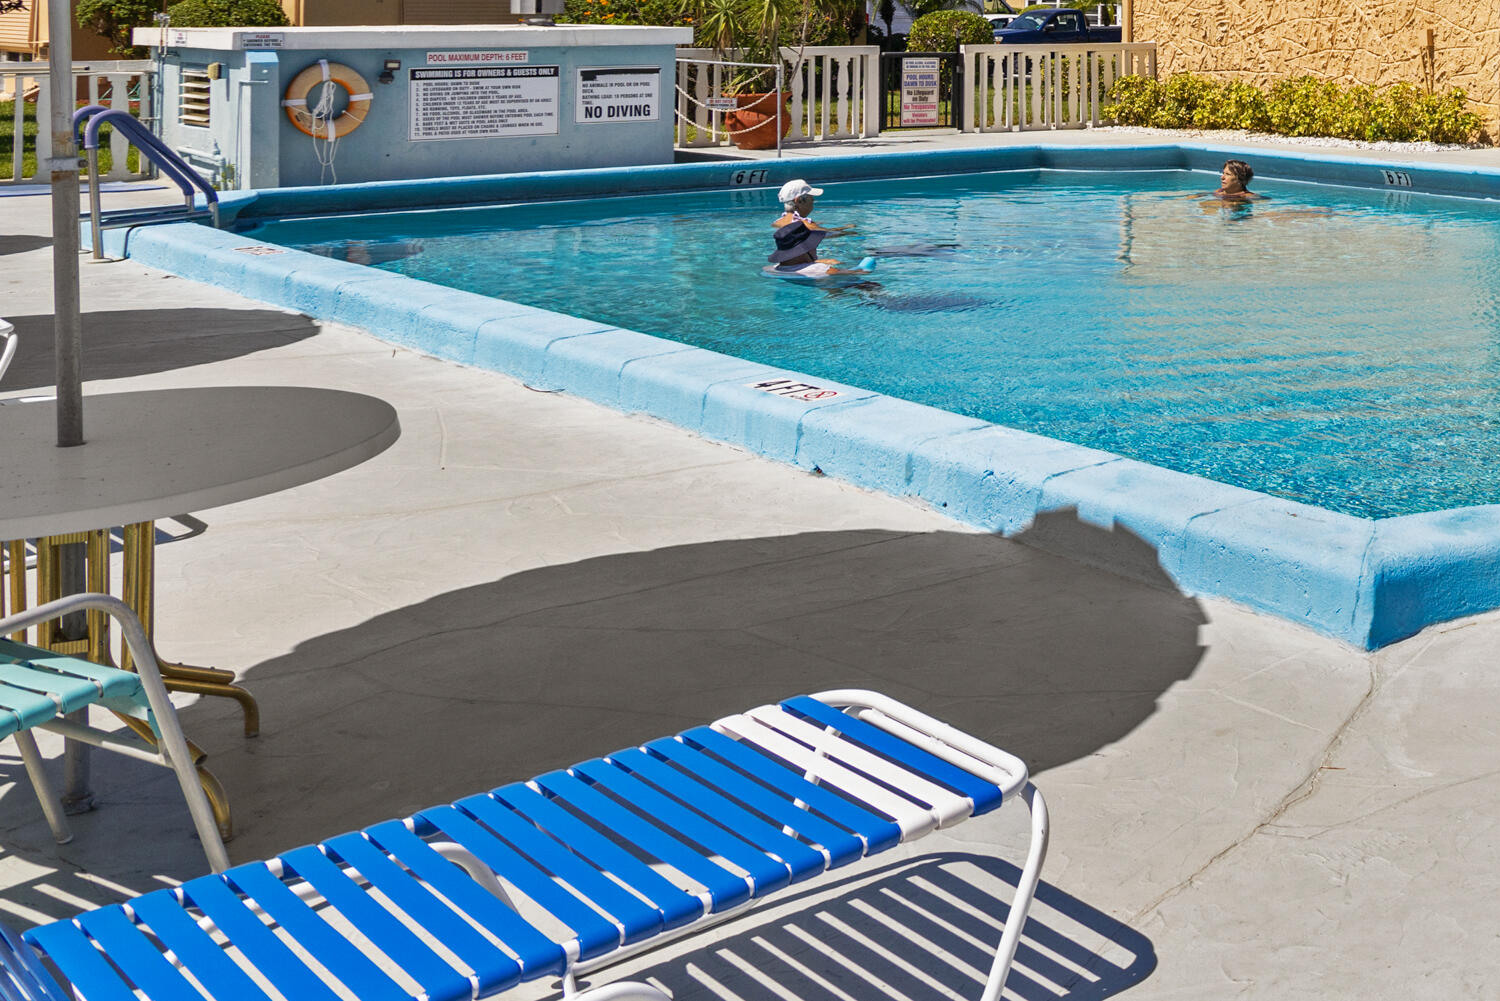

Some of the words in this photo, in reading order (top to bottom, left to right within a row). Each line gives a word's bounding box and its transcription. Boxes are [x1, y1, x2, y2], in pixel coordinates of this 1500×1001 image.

[428, 54, 447, 62] POOL
[481, 53, 504, 61] DEPTH:
[477, 69, 505, 77] OWNERS
[513, 68, 537, 76] GUESTS
[585, 106, 602, 118] NO
[608, 104, 651, 118] DIVING
[736, 170, 746, 184] 6
[749, 170, 768, 184] FT
[1386, 171, 1394, 184] 6
[754, 380, 792, 388] 4
[766, 384, 821, 395] FT
